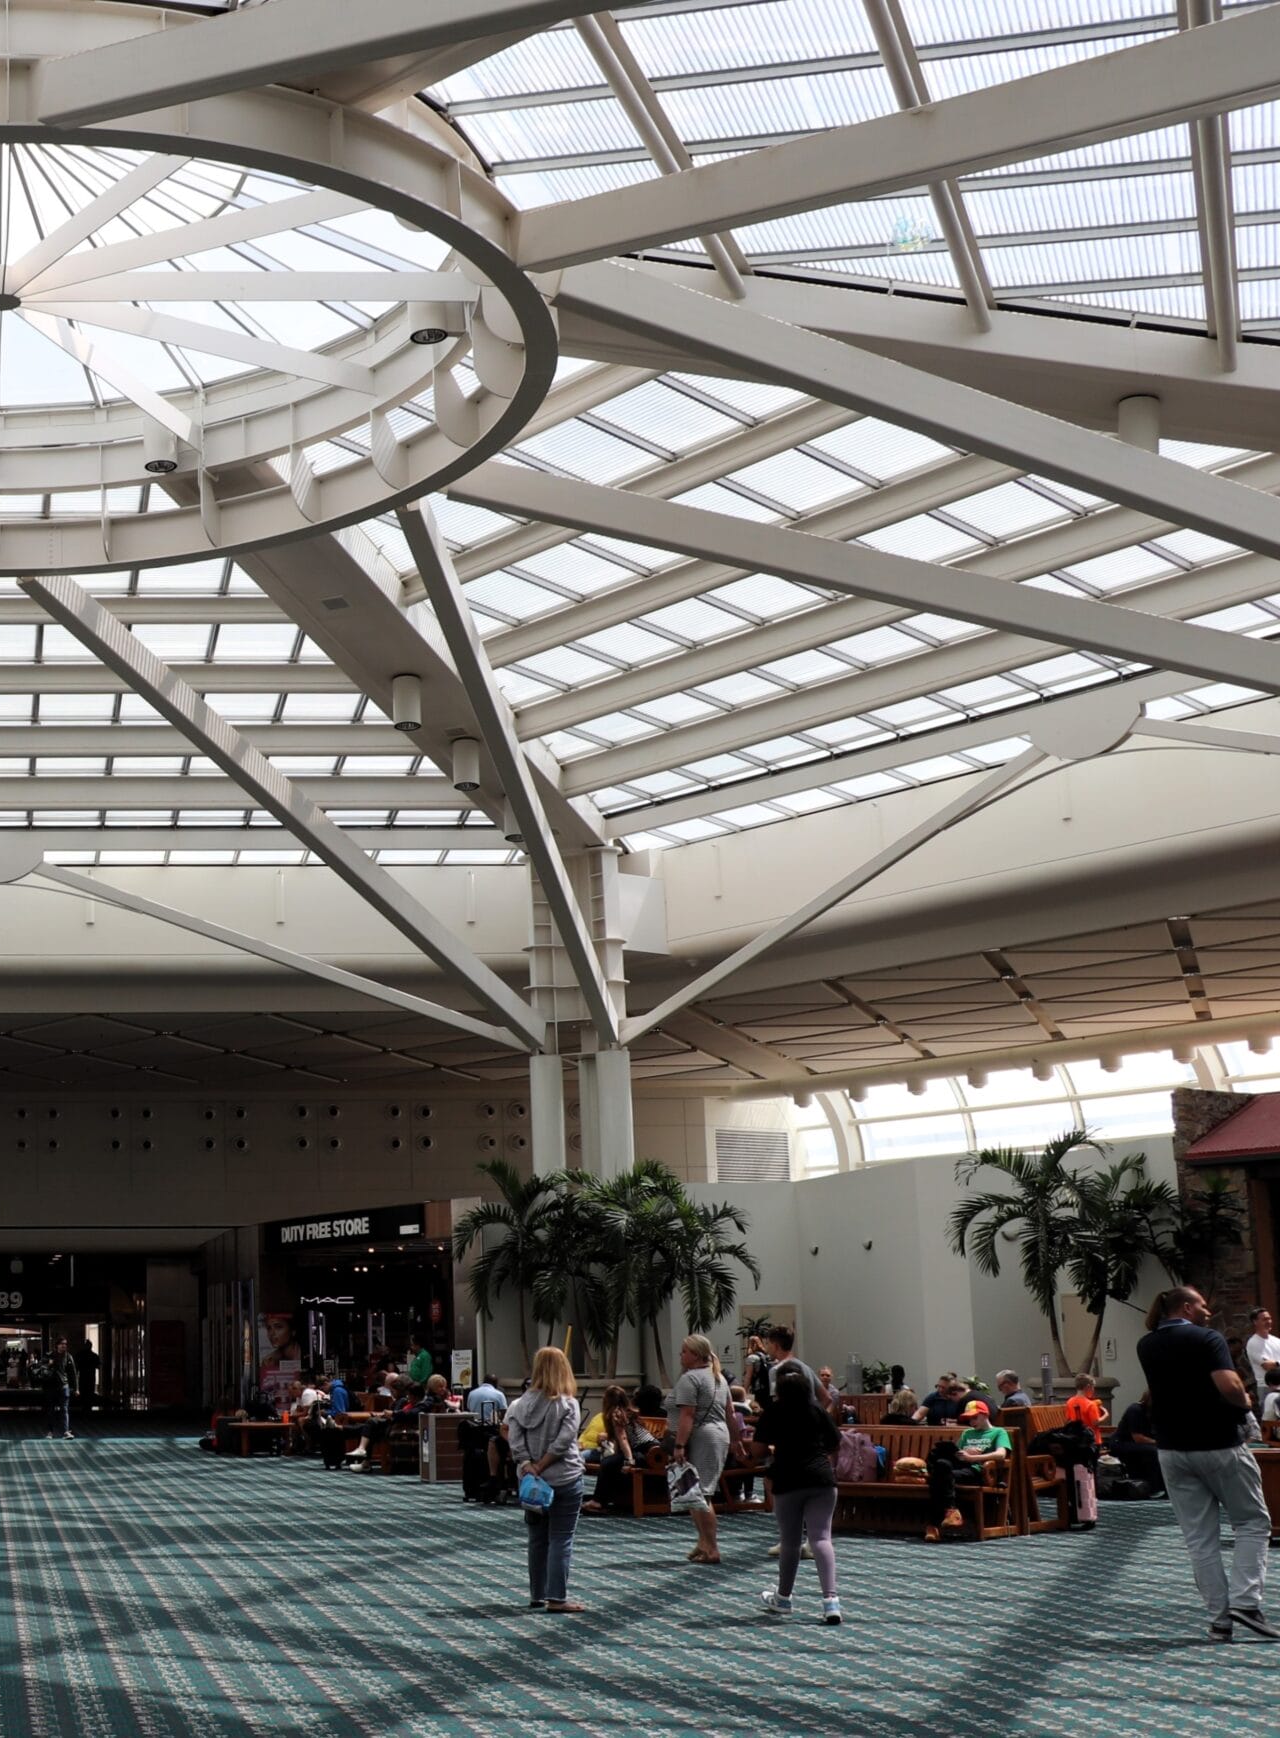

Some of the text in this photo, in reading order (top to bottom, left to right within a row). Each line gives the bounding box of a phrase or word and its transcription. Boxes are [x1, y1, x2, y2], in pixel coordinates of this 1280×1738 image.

[281, 1217, 370, 1243] DUTY FREE STORE
